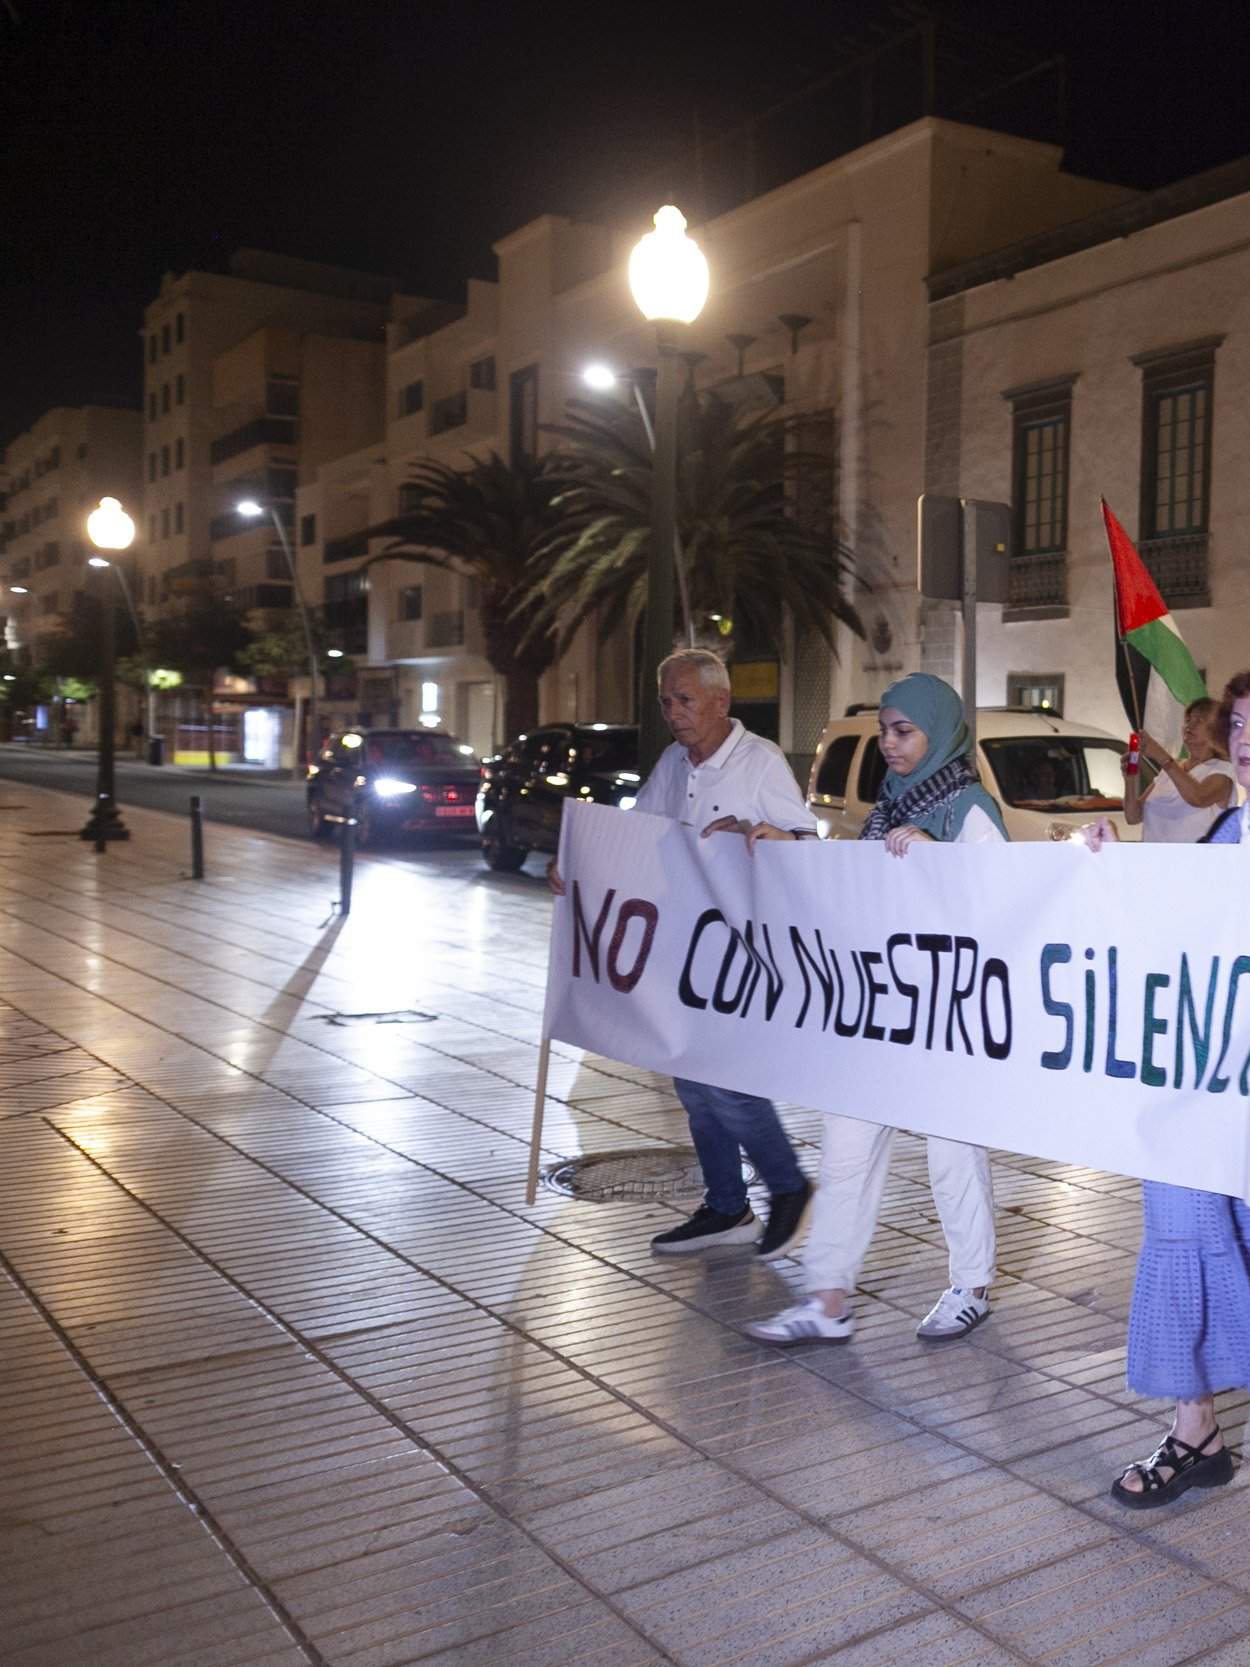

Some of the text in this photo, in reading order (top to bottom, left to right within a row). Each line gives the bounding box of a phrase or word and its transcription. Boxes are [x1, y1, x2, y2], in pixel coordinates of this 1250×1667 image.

[572, 879, 659, 994] NO
[677, 908, 784, 1021] CON
[790, 925, 1013, 1060] NUESTRO
